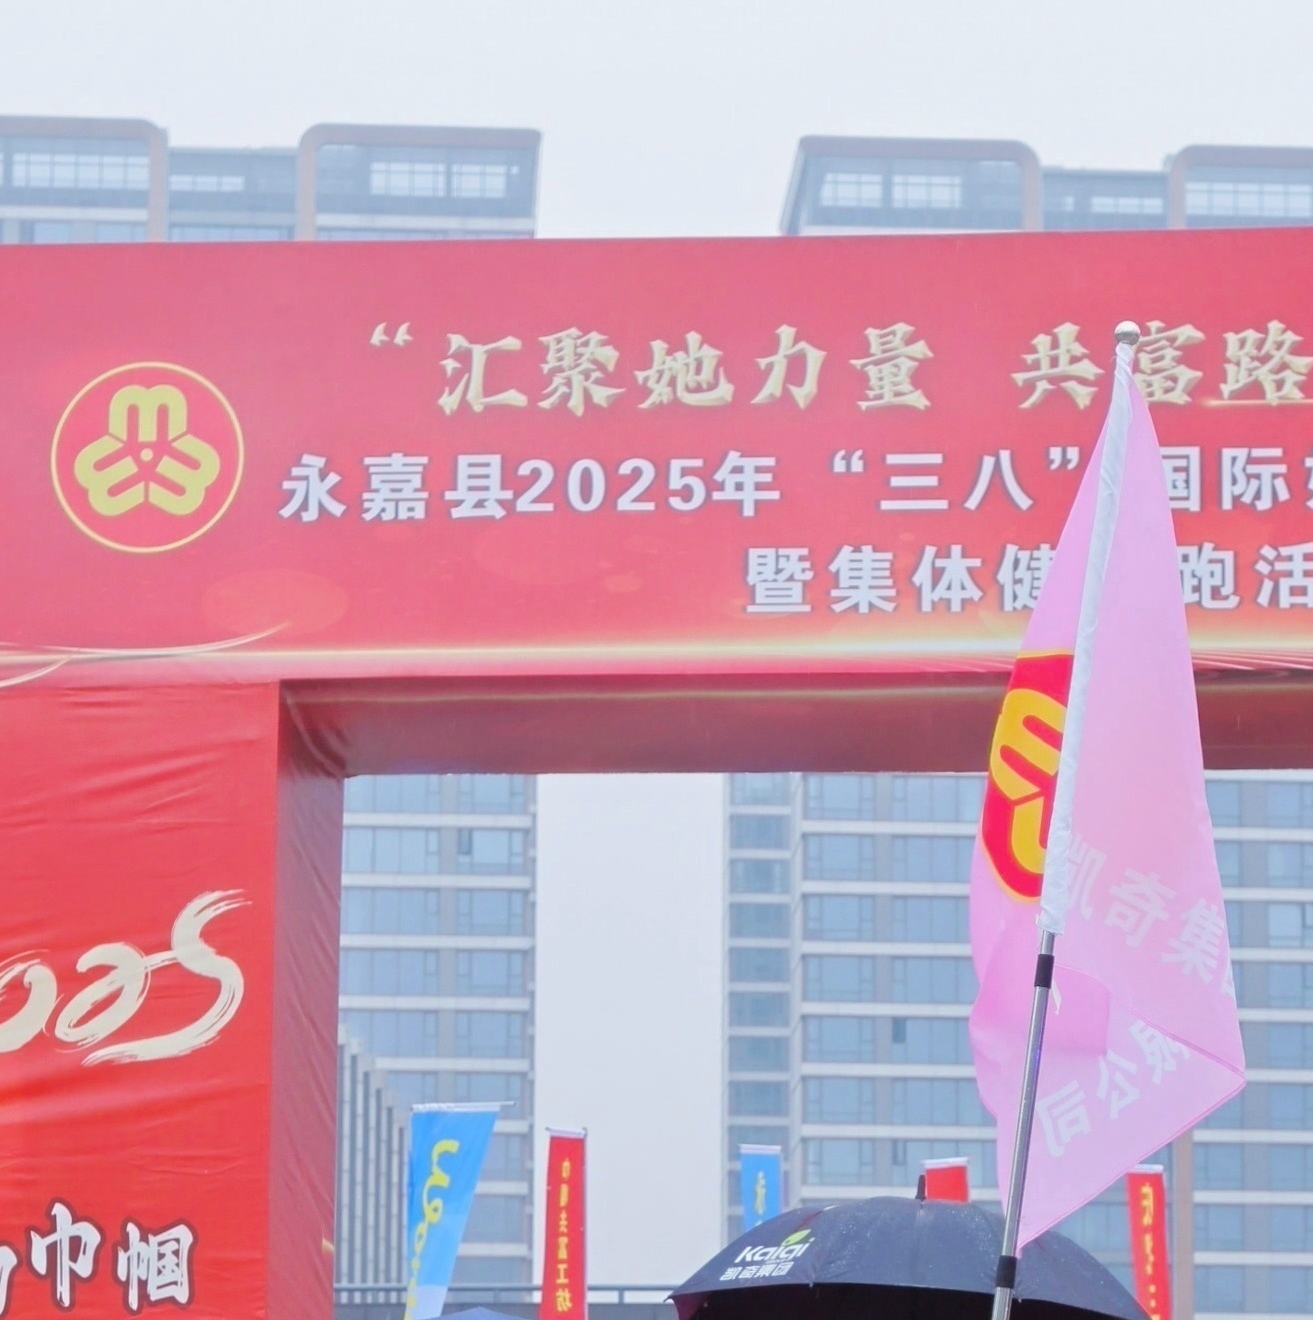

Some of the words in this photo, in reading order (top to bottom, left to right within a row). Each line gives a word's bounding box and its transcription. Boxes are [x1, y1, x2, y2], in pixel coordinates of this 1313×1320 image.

[369, 321, 936, 418] “汇聚她力量
[1066, 832, 1236, 1002] 凯奇集
[719, 1260, 796, 1281] 凯奇集团
